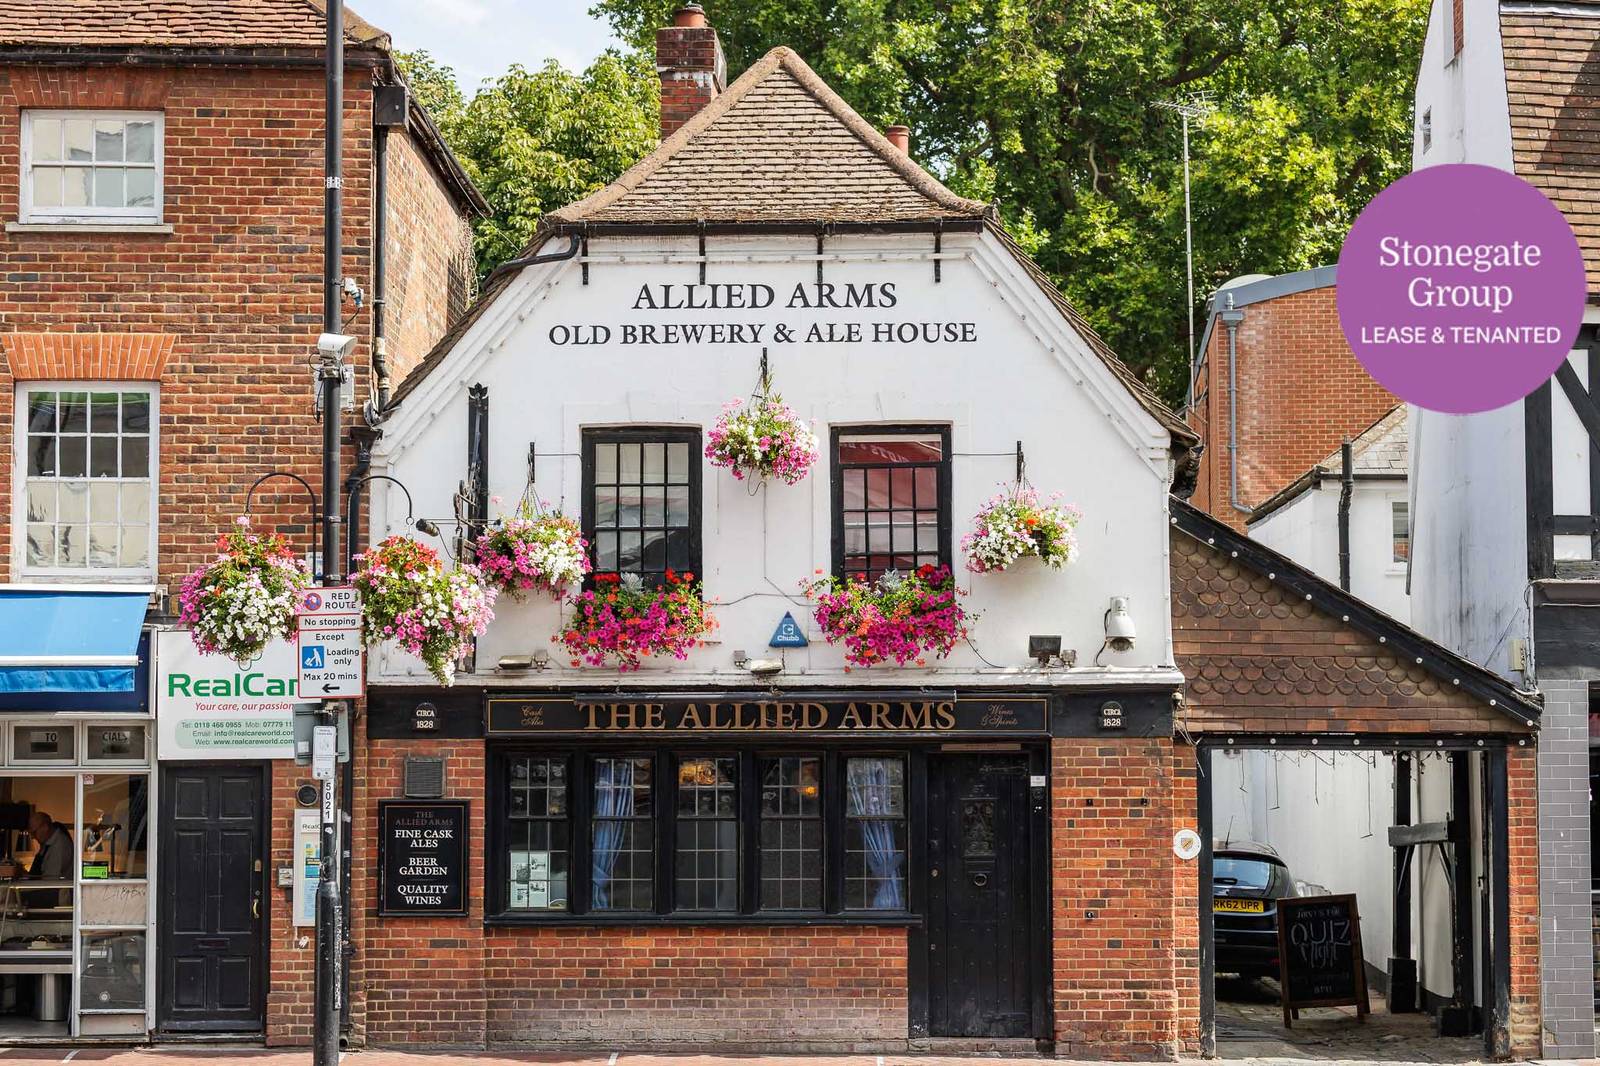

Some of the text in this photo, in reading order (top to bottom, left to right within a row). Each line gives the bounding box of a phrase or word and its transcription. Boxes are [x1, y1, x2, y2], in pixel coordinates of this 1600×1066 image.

[631, 282, 898, 310] ALLIED ARMS
[549, 322, 977, 346] OLD BREWERY & ALE HOUSE
[331, 592, 350, 600] RED
[304, 617, 356, 627] No stopping
[315, 633, 345, 641] Except
[326, 648, 359, 657] Loading
[333, 658, 352, 666] only
[323, 672, 336, 680] 20
[337, 671, 358, 680] mins
[168, 673, 298, 697] RealCar
[195, 702, 294, 712] Your care, our passion
[416, 709, 435, 717] CIRCA
[579, 702, 956, 730] THE ALLIED ARMS
[1103, 708, 1122, 716] CIRCA
[416, 721, 434, 729] 1828
[1103, 718, 1121, 727] 1828
[394, 829, 454, 839] FINE CASK
[410, 839, 438, 848] ALES
[409, 857, 438, 866] BEER
[399, 866, 448, 875] GARDEN
[397, 884, 448, 895] QUALITY
[404, 896, 442, 904] WINES
[1214, 900, 1259, 910] RK62 UPR
[1291, 920, 1350, 946] QUIZ
